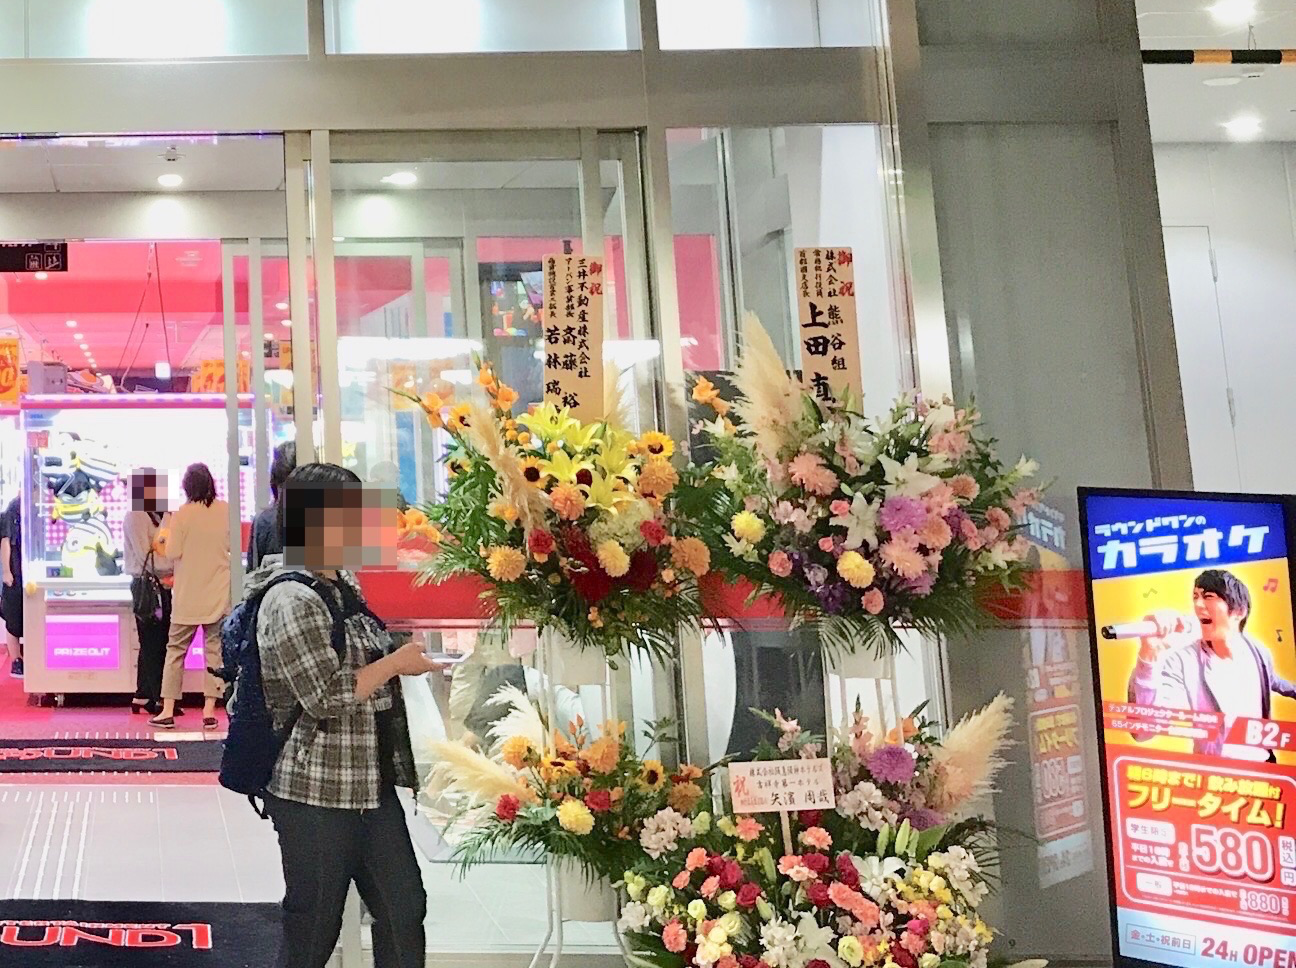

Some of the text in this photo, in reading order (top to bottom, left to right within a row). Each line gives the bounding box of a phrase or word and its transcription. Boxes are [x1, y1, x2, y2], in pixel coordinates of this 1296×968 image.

[577, 258, 591, 379] 三井不動産株式会社
[1094, 514, 1207, 537] ラウンドワンの
[1096, 524, 1270, 571] カラオケ
[1245, 719, 1291, 748] B2F
[1127, 783, 1285, 830] フリータイム!
[1192, 824, 1274, 881] 580
[1247, 891, 1282, 915] 880
